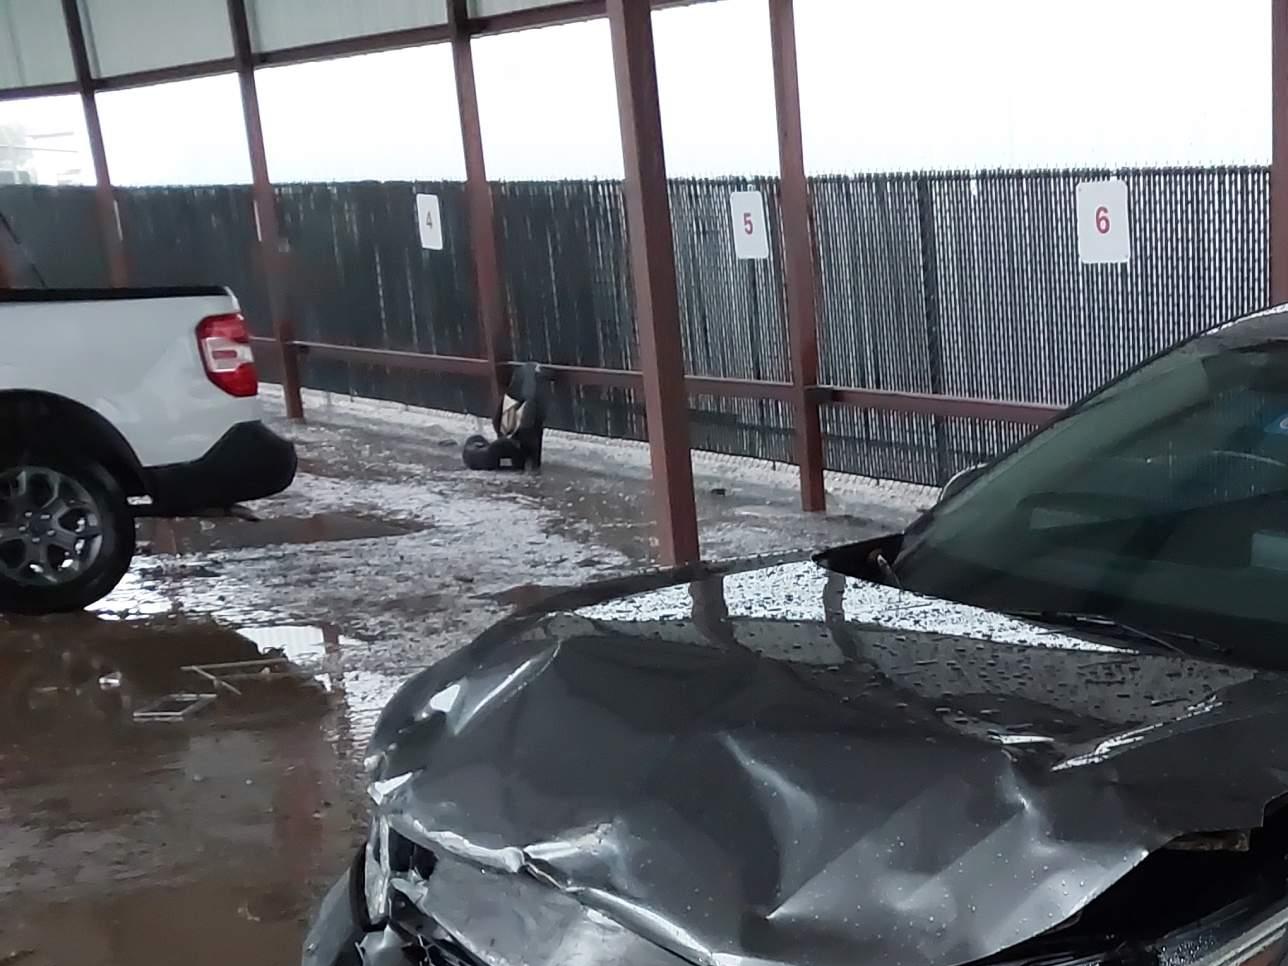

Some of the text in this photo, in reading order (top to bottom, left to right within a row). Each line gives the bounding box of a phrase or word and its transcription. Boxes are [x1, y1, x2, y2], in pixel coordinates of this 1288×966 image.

[425, 211, 433, 229] 4
[743, 212, 753, 235] 5
[1095, 206, 1110, 234] 6
